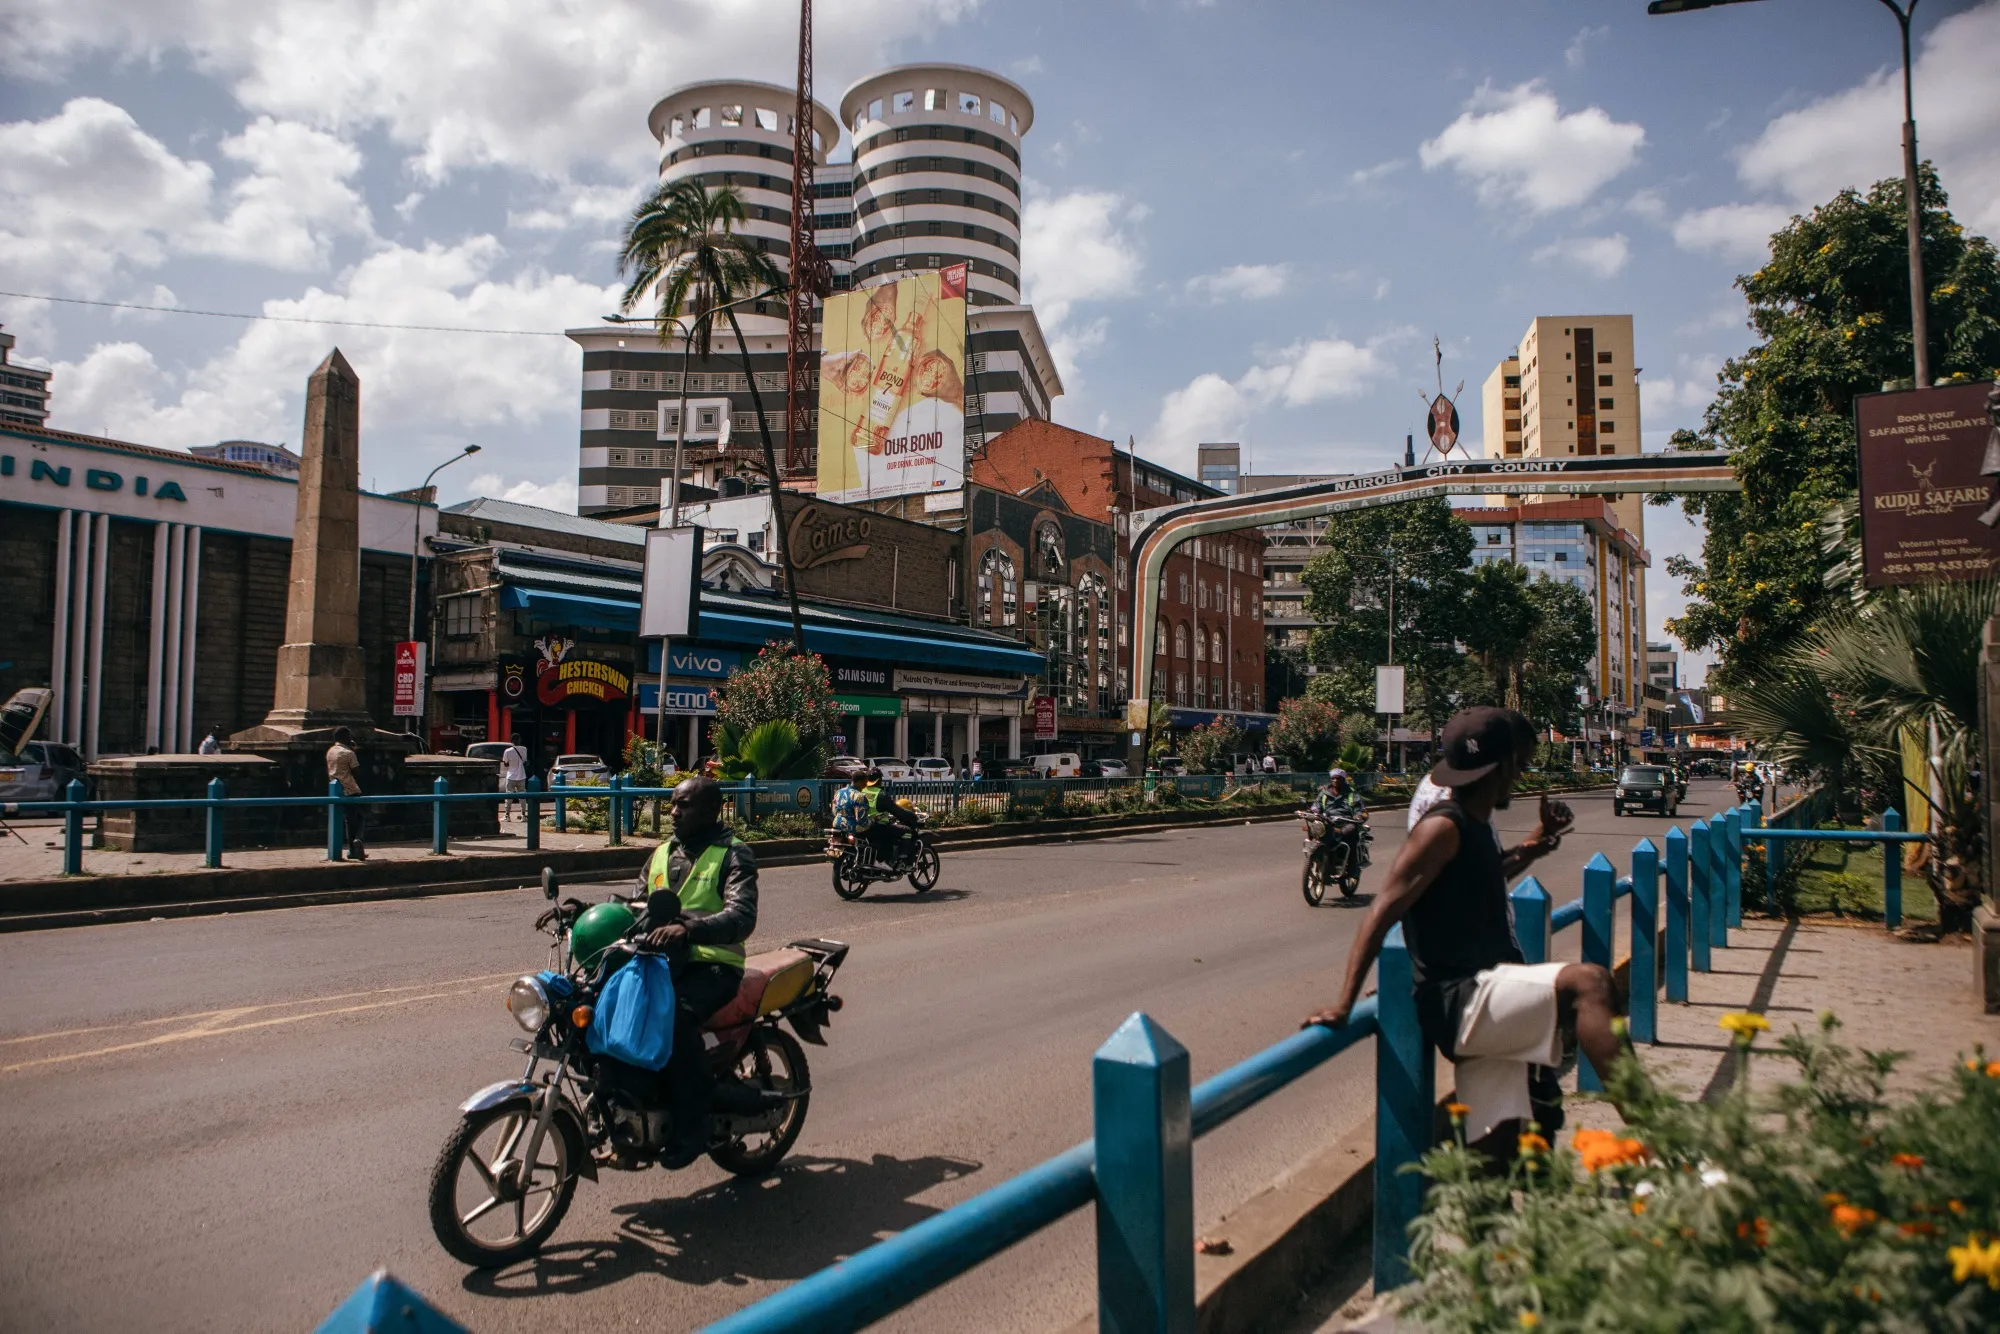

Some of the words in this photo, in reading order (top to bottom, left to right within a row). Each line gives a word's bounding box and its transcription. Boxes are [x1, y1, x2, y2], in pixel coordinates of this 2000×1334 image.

[880, 371, 904, 386] BOND
[882, 382, 892, 395] 7
[872, 400, 892, 412] WHISKY
[1897, 412, 1926, 423] Book
[1928, 410, 1956, 422] your
[1869, 425, 1916, 437] SAFARIS
[1917, 424, 1926, 432] &
[1928, 417, 1987, 431] HOLIDAYS
[884, 437, 908, 456] OUR
[910, 431, 942, 452] BOND
[1904, 435, 1930, 444] with
[1932, 434, 1950, 442] us.
[886, 462, 896, 470] OUR
[914, 458, 924, 466] OUR
[1, 455, 188, 502] INDIA
[1334, 474, 1403, 492] NAIROBI
[1426, 465, 1466, 478] CITY
[1490, 462, 1568, 472] COUNTY
[1326, 502, 1350, 513] FOR
[1360, 500, 1370, 508] A
[1380, 488, 1435, 504] GREENER
[1446, 485, 1472, 494] AND
[1483, 484, 1546, 494] CLEANER
[1558, 484, 1592, 492] CITY
[1874, 492, 1920, 509] KUDU
[1924, 486, 1990, 505] SAFARIS
[1898, 540, 1935, 548] Veteran
[1937, 538, 1968, 546] House
[1904, 550, 1939, 558] Avenue
[1882, 564, 1912, 574] +254
[1964, 558, 1990, 569] 025
[672, 652, 722, 672] vivo
[398, 673, 414, 684] CBD
[838, 668, 885, 684] SAMSUNG
[903, 674, 922, 684] Nairobi
[922, 676, 932, 685] City
[934, 678, 948, 686] Water
[958, 680, 980, 689] Sewerage
[980, 682, 1001, 690] Company
[1002, 683, 1019, 691] Limited
[566, 681, 604, 698] CHICKEN
[756, 792, 791, 802] Sanlam
